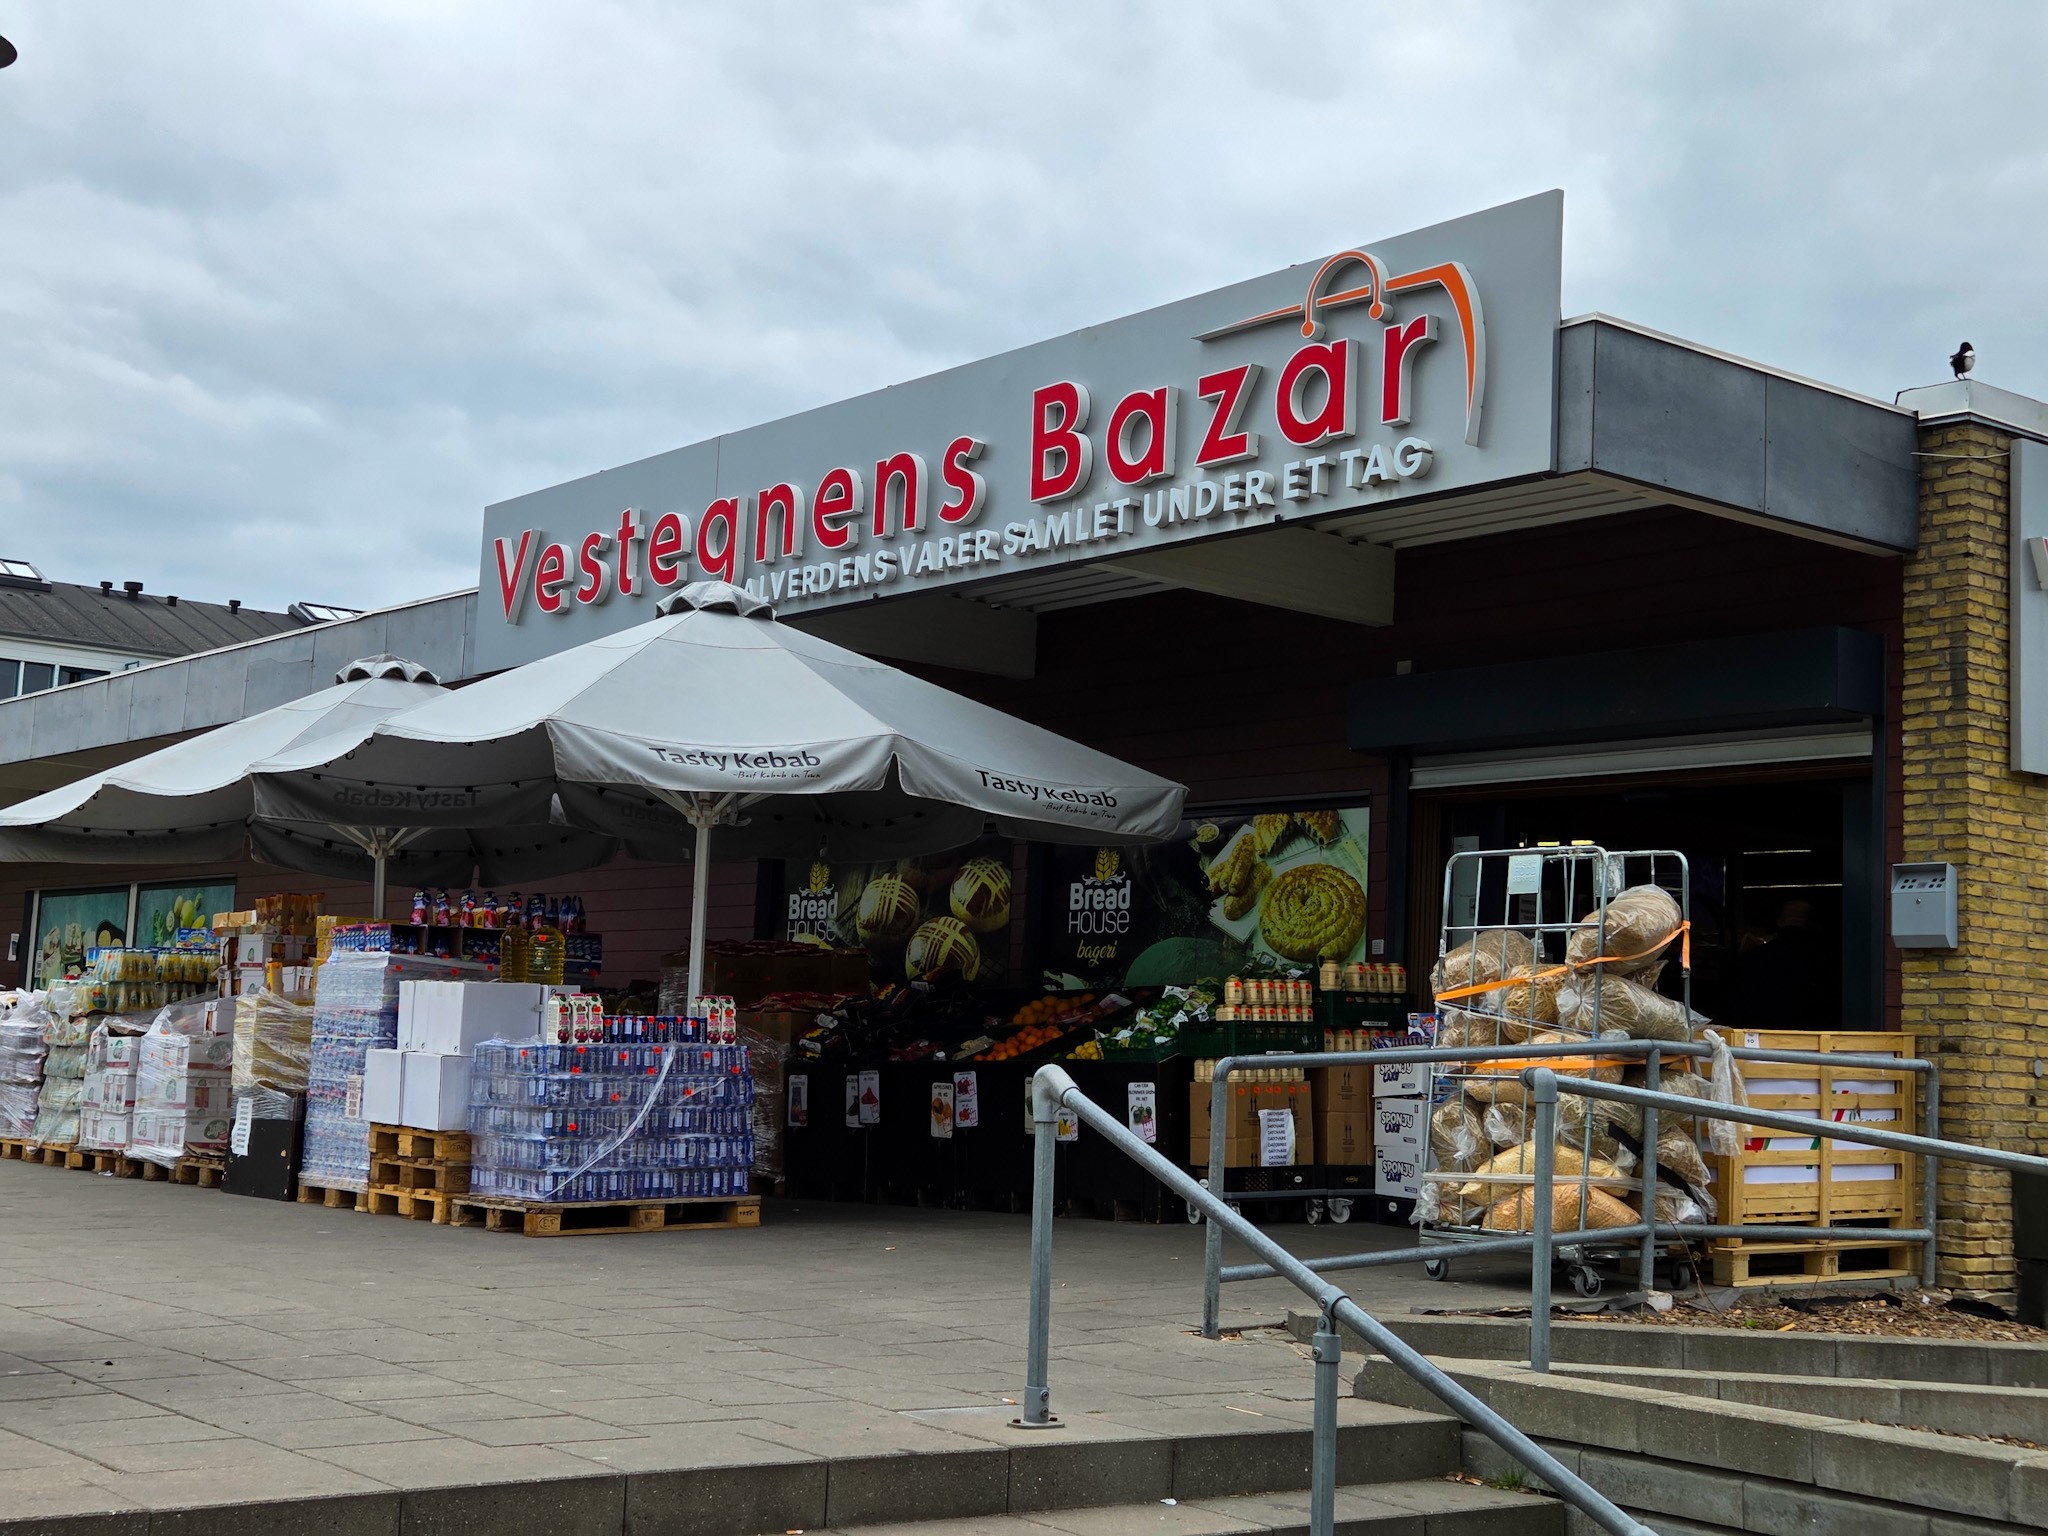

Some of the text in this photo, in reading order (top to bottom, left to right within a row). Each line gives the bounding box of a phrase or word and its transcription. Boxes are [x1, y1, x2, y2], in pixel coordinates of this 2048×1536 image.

[494, 313, 1438, 625] Vestegnens Bazar
[899, 528, 999, 577] VARER
[1002, 497, 1140, 556] SAMLET
[1143, 470, 1275, 529] UNDER
[1283, 456, 1336, 500] ET
[1340, 437, 1432, 490] TAG
[648, 747, 821, 771] Tasty Kebab
[975, 770, 1118, 808] Tasty Kebab
[788, 892, 838, 920] Bread
[1069, 880, 1131, 910] Bread
[1077, 939, 1117, 967] bageri
